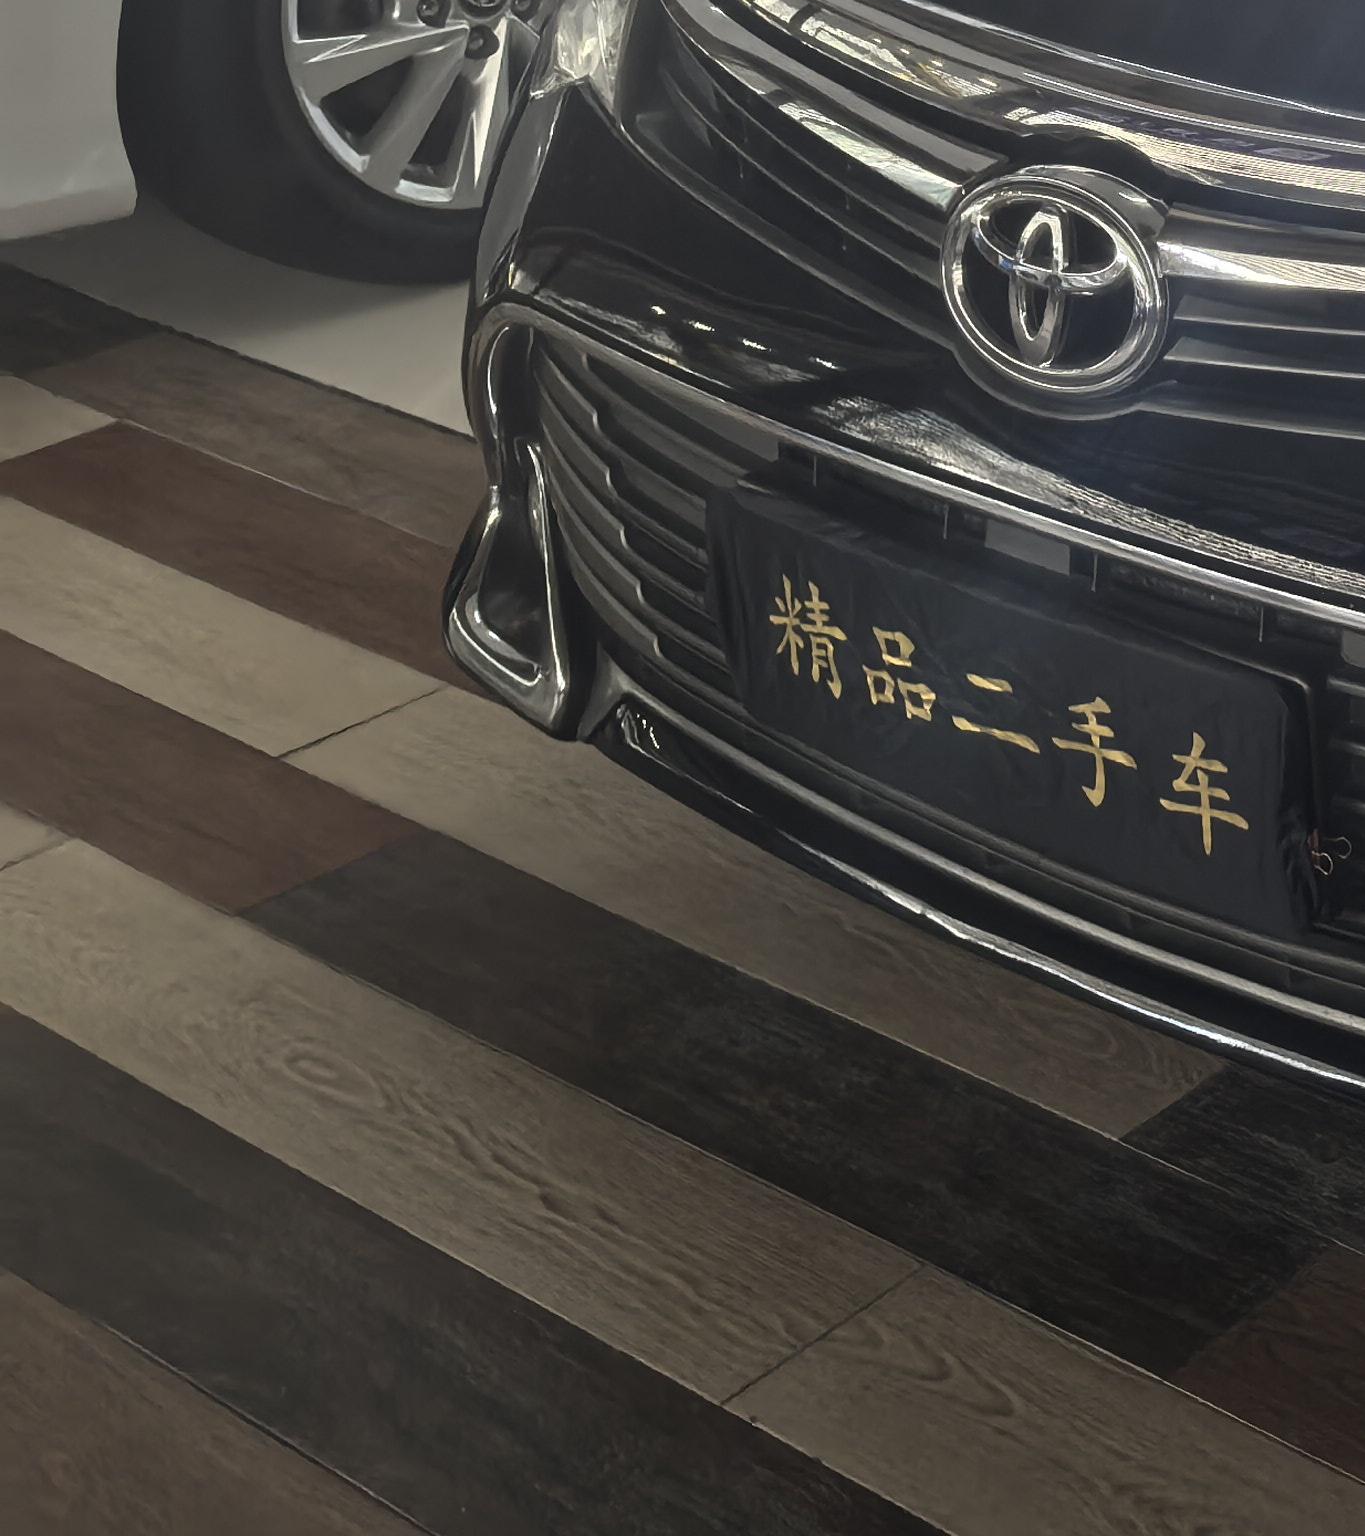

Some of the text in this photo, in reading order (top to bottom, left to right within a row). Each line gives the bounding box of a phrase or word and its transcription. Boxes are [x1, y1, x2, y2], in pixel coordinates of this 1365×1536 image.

[769, 574, 1249, 856] 精品二手车
